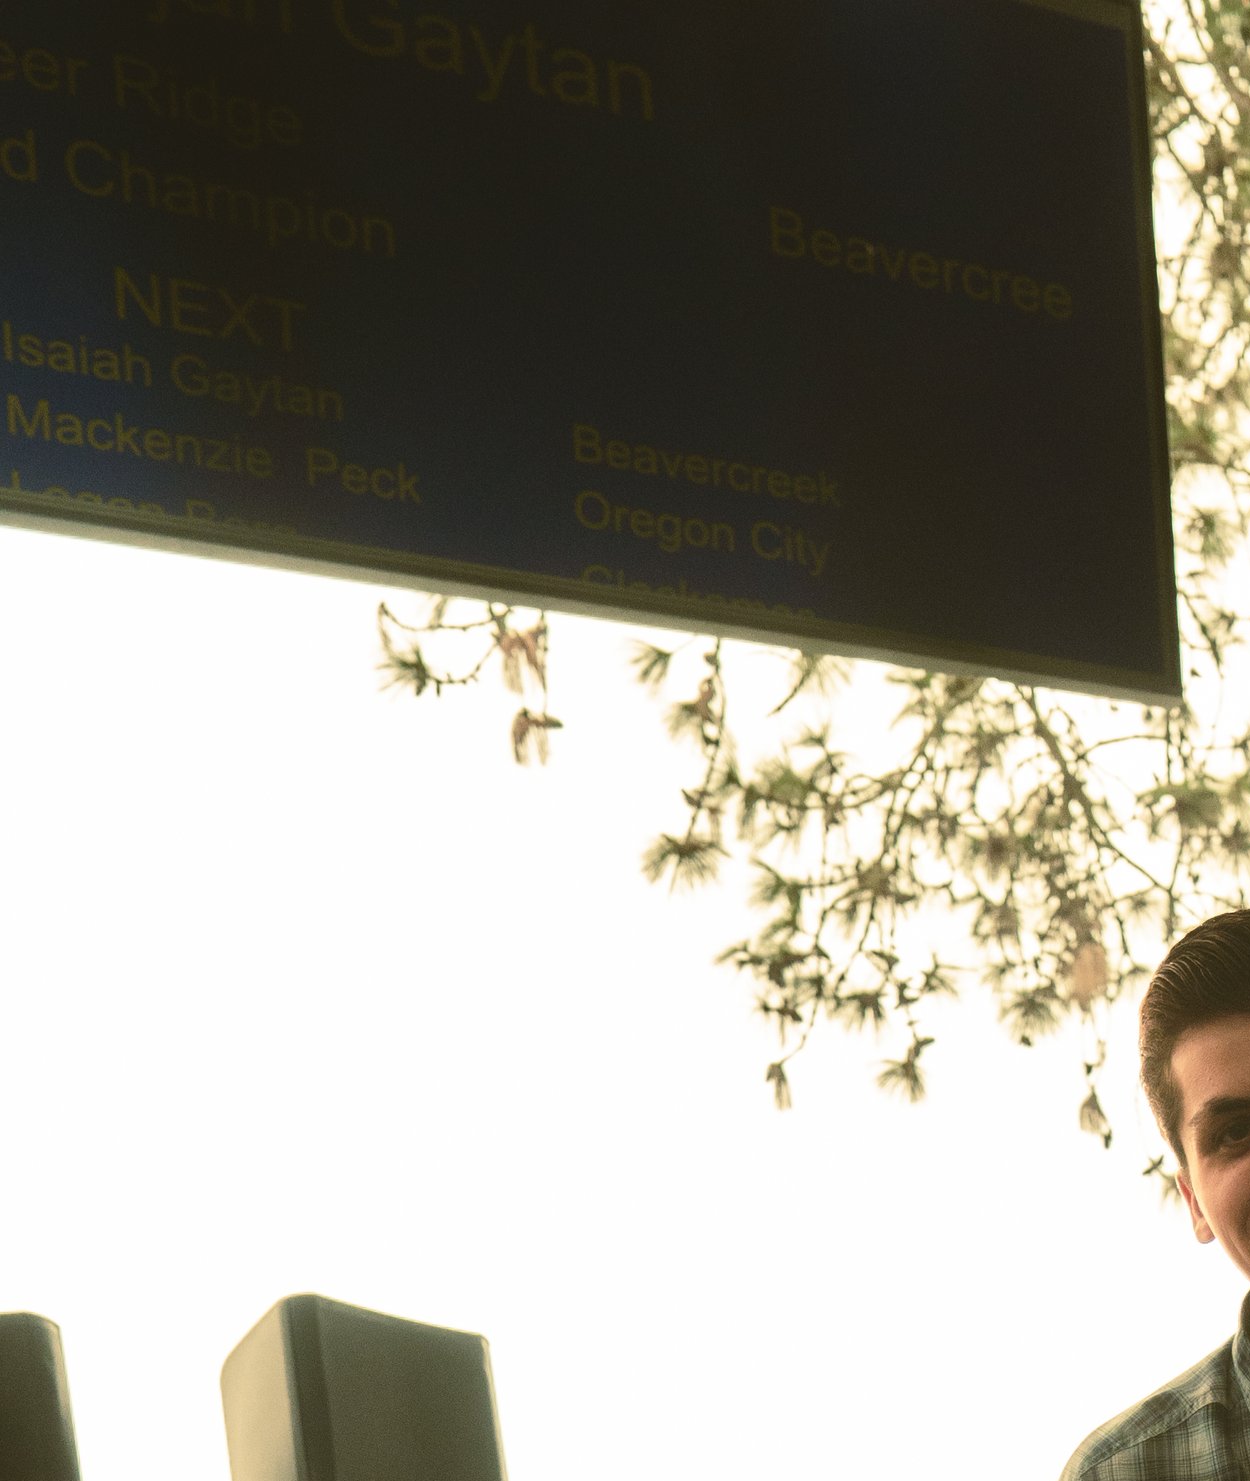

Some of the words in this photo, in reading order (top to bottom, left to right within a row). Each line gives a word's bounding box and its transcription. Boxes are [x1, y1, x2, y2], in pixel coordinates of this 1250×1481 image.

[113, 53, 305, 150] Ridge
[332, 0, 655, 122] Gaytan
[64, 139, 398, 258] Champion
[112, 264, 308, 354] NEXT
[768, 205, 1074, 320] Beavercree
[2, 318, 153, 387] Isaiah
[170, 352, 345, 422] Gaytan
[6, 393, 274, 478] Mackenzie
[305, 445, 424, 505] Peck
[570, 422, 842, 507] Beavercreek
[573, 488, 736, 554] Oregon
[750, 519, 832, 578] City
